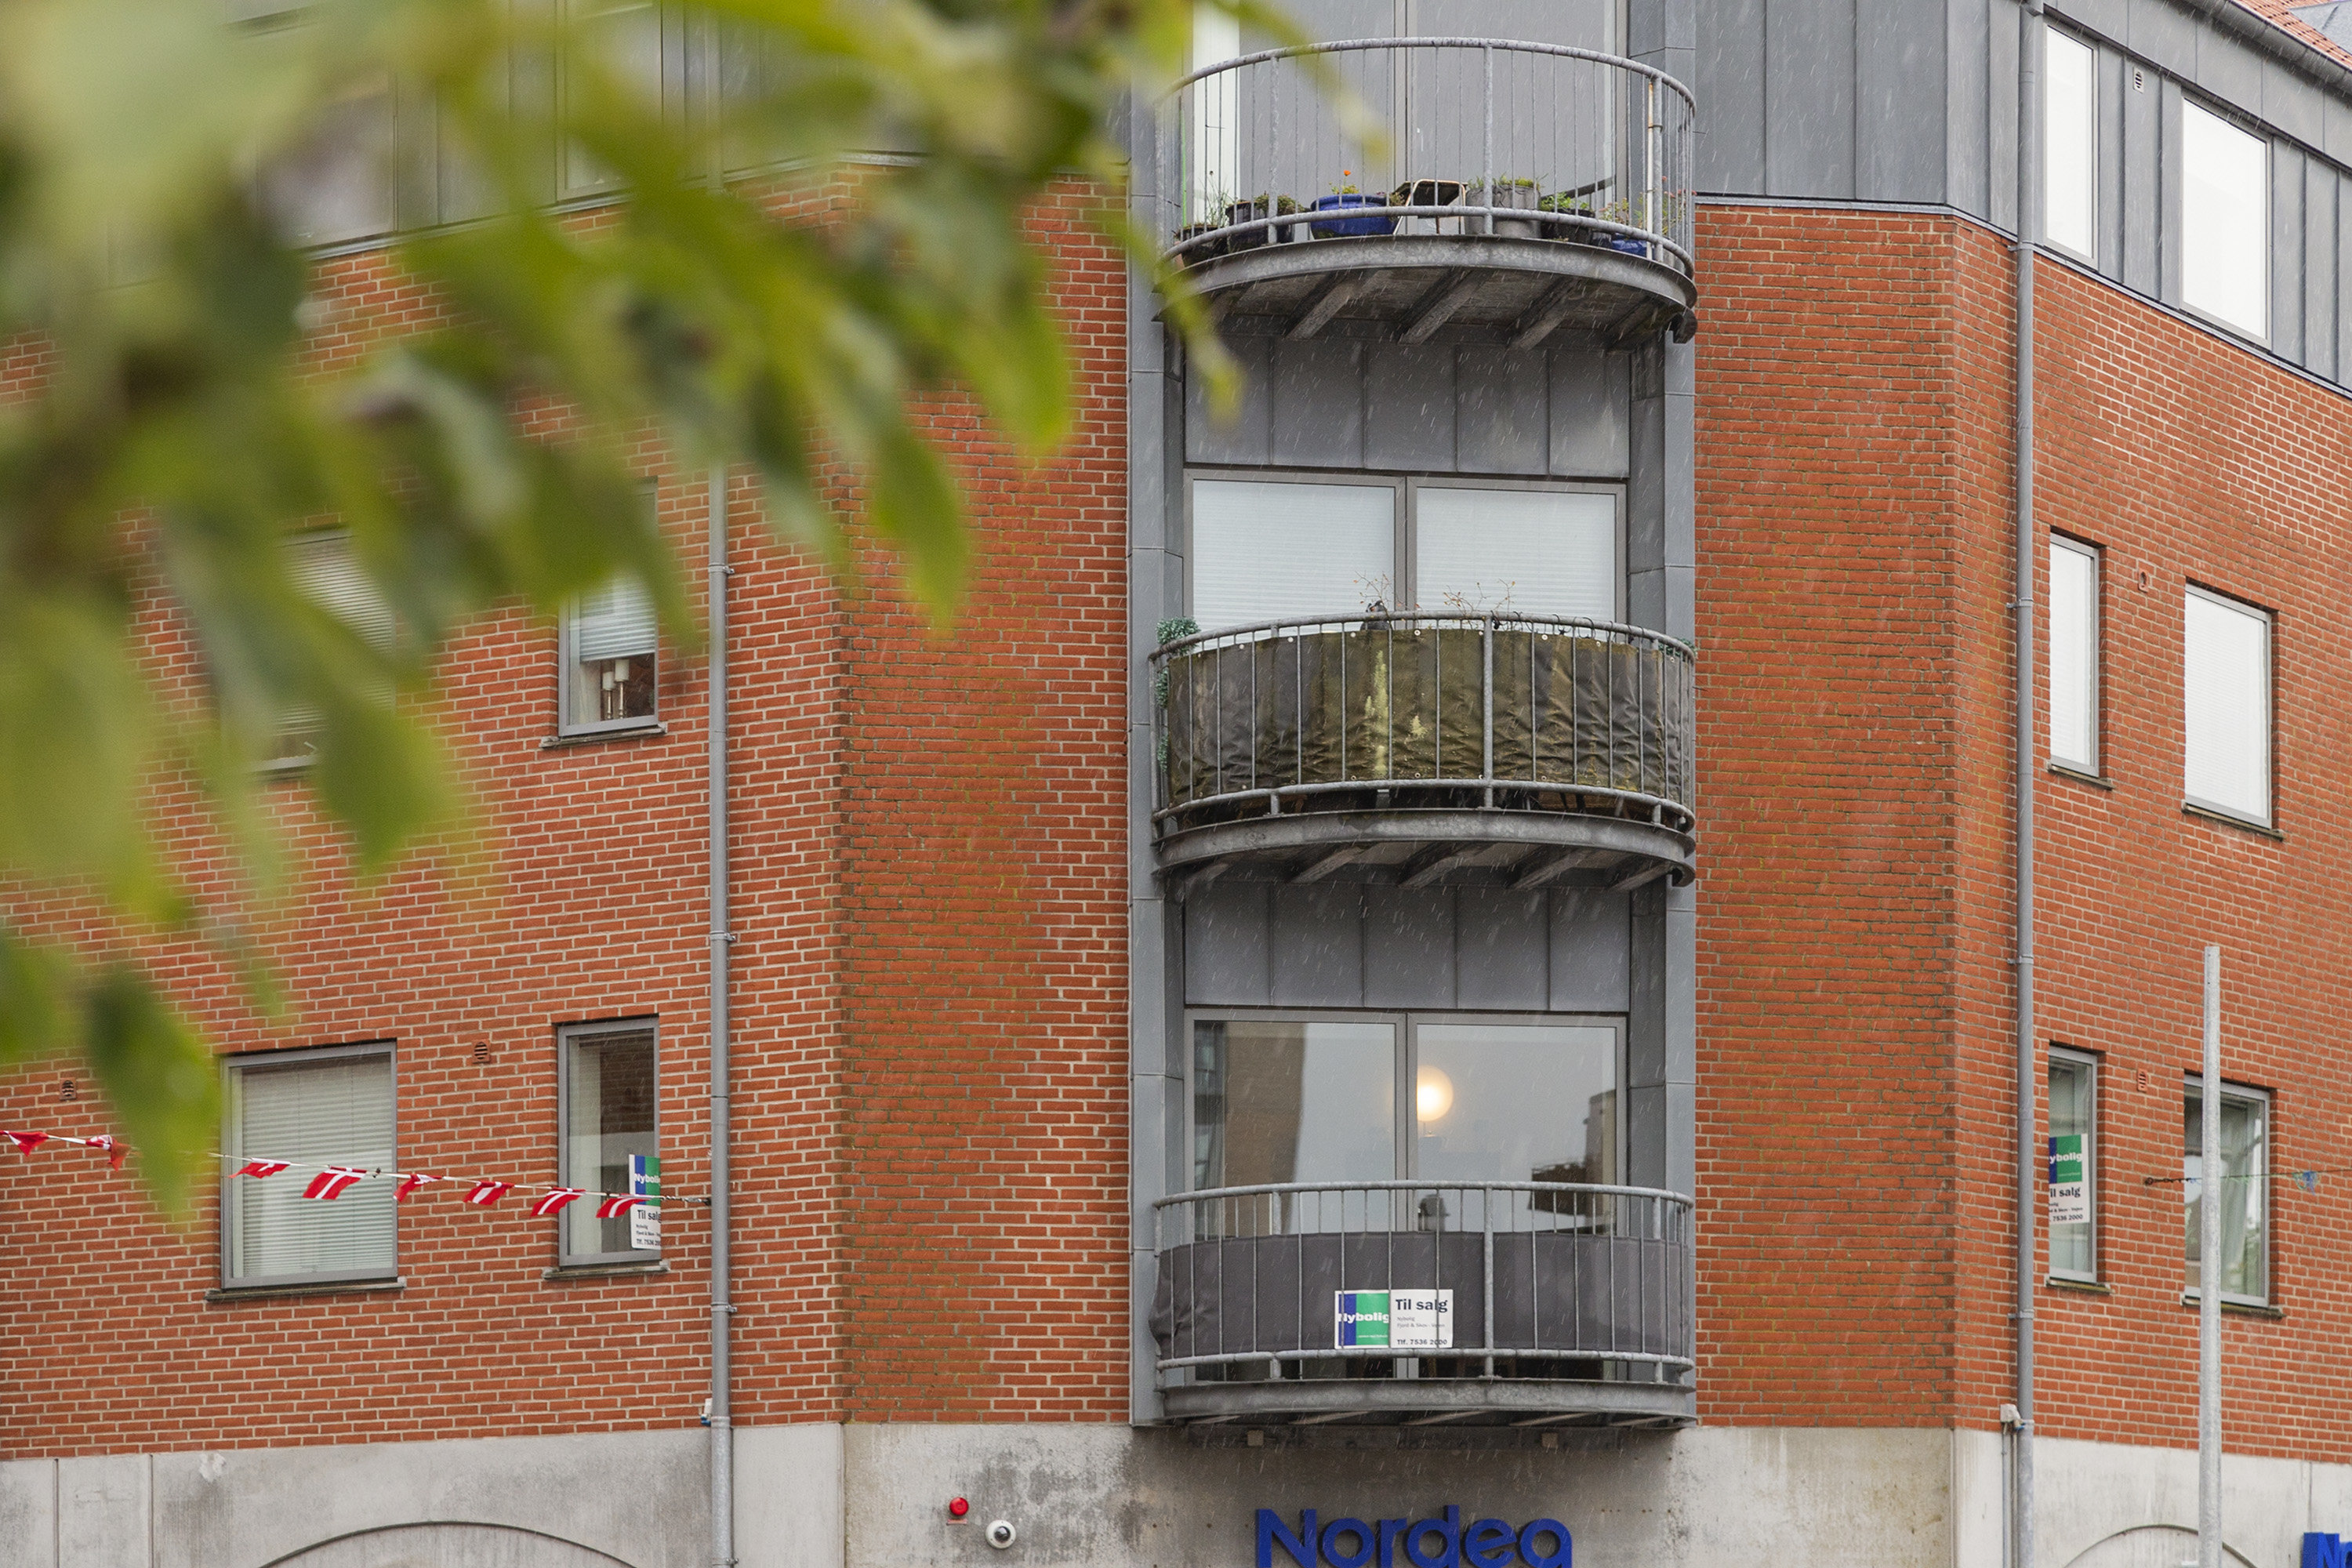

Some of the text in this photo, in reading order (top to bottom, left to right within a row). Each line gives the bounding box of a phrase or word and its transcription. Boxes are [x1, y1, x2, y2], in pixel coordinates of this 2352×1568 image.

[2049, 1152, 2082, 1164] ybolig
[634, 1173, 661, 1184] Nyboli
[2059, 1186, 2081, 1198] salg
[637, 1210, 646, 1219] Til
[1396, 1298, 1448, 1313] Til salg
[1338, 1312, 1389, 1323] Nybolig
[1257, 1504, 1573, 1568] Nordea
